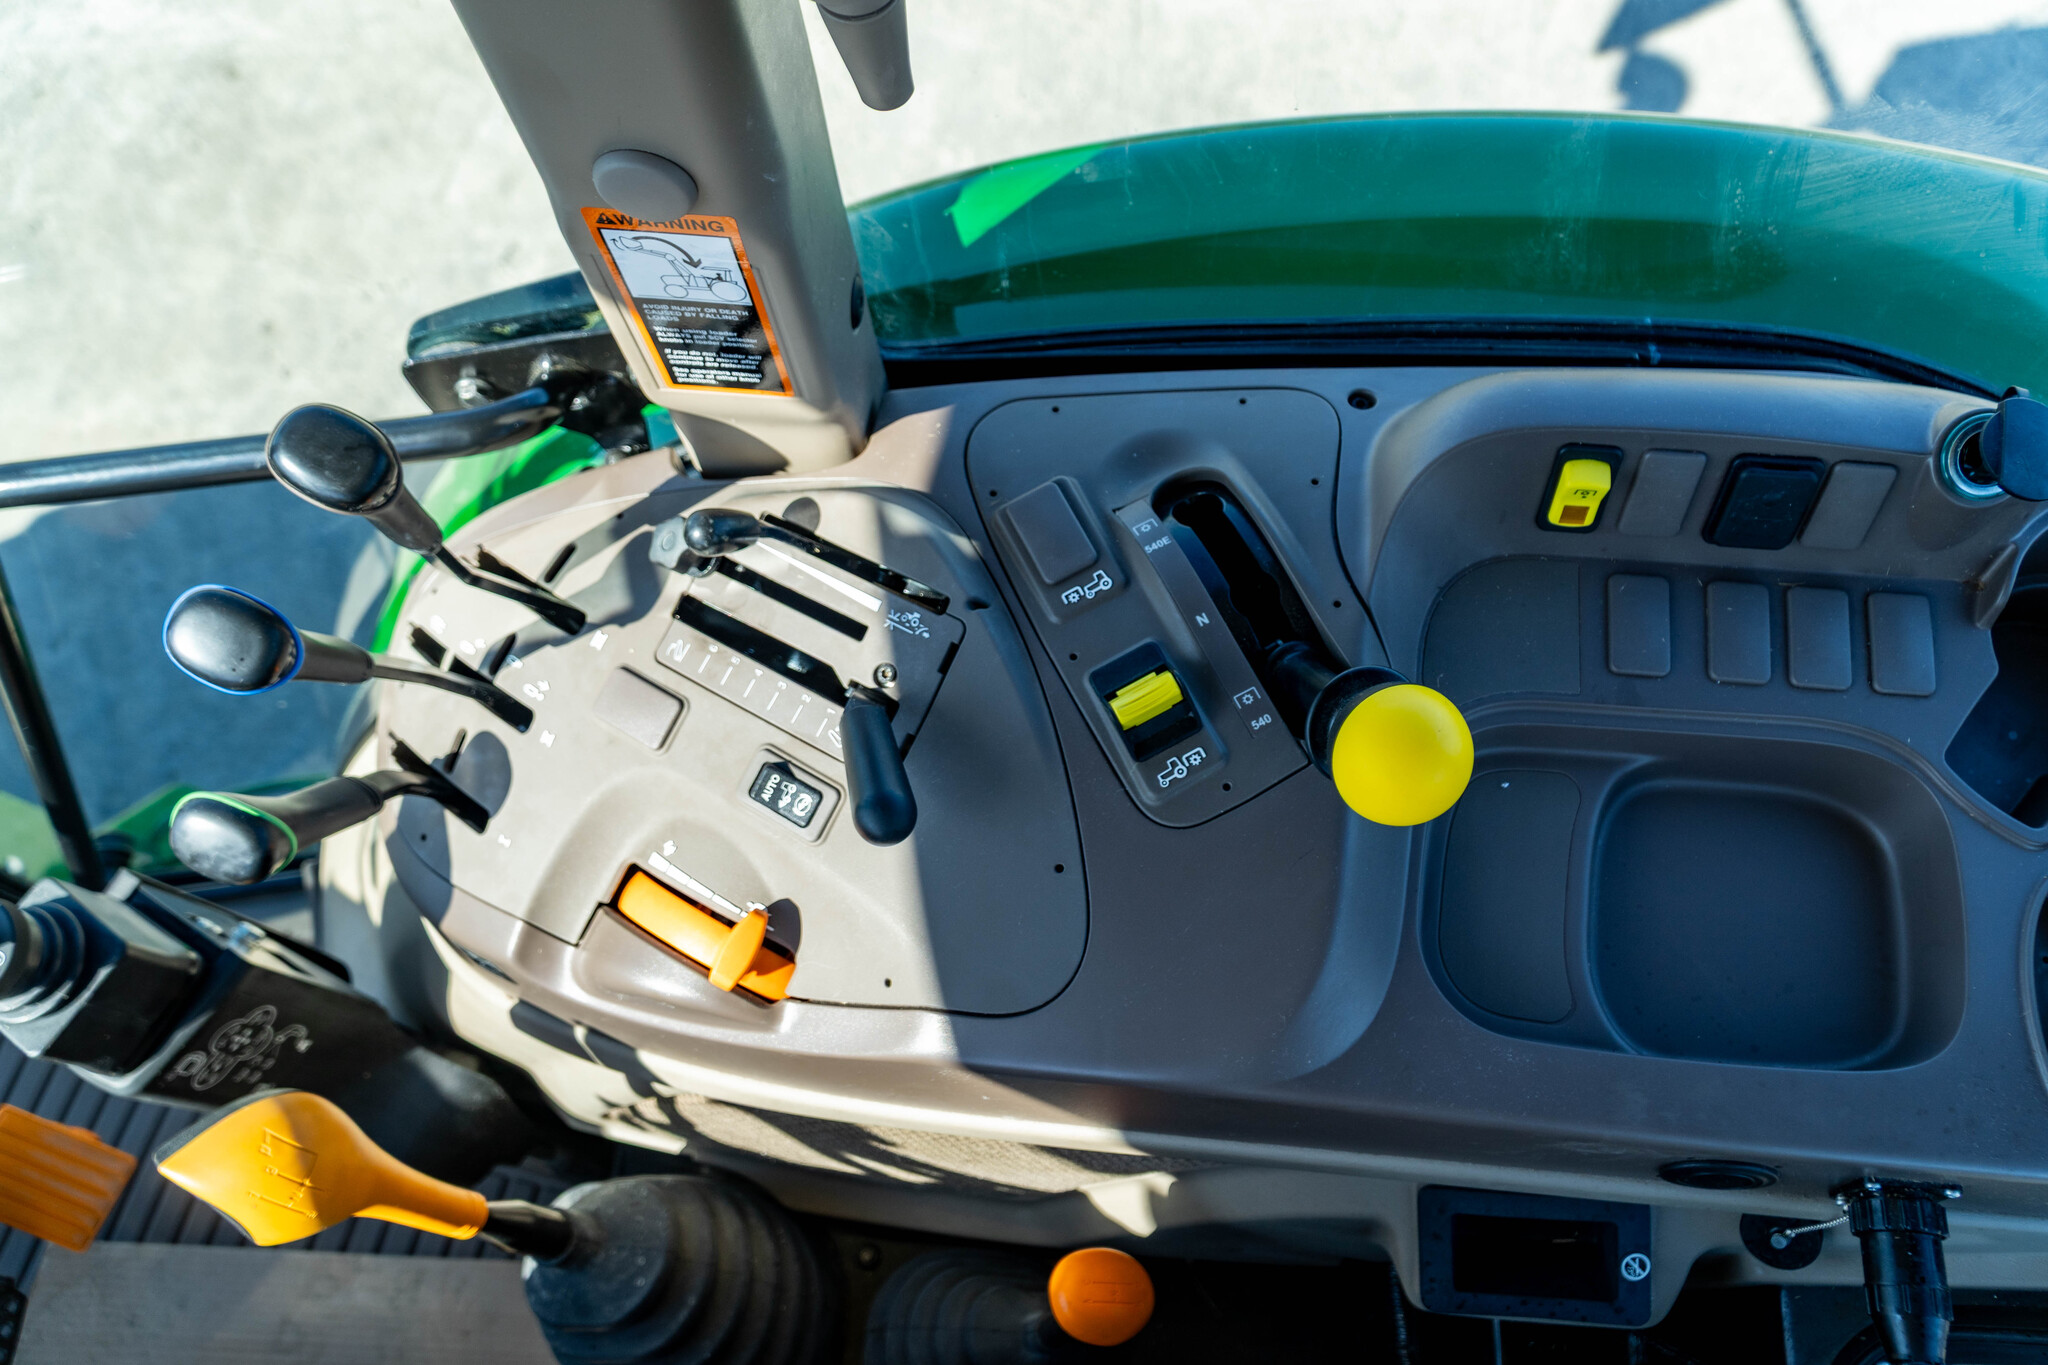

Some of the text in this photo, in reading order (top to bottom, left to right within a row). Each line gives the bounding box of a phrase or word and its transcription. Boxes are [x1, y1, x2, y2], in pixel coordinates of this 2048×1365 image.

[644, 309, 682, 317] CAUSED
[699, 313, 739, 321] FALLING
[719, 308, 749, 316] DEATH
[1144, 535, 1172, 554] 540E
[1195, 612, 1210, 627] N
[708, 643, 719, 653] 6
[730, 655, 741, 666] 5
[754, 667, 764, 677] 4
[777, 680, 788, 690] 3
[801, 693, 812, 704] 2
[826, 707, 837, 715] 1
[1251, 713, 1272, 731] 540
[760, 774, 781, 802] AUTO
